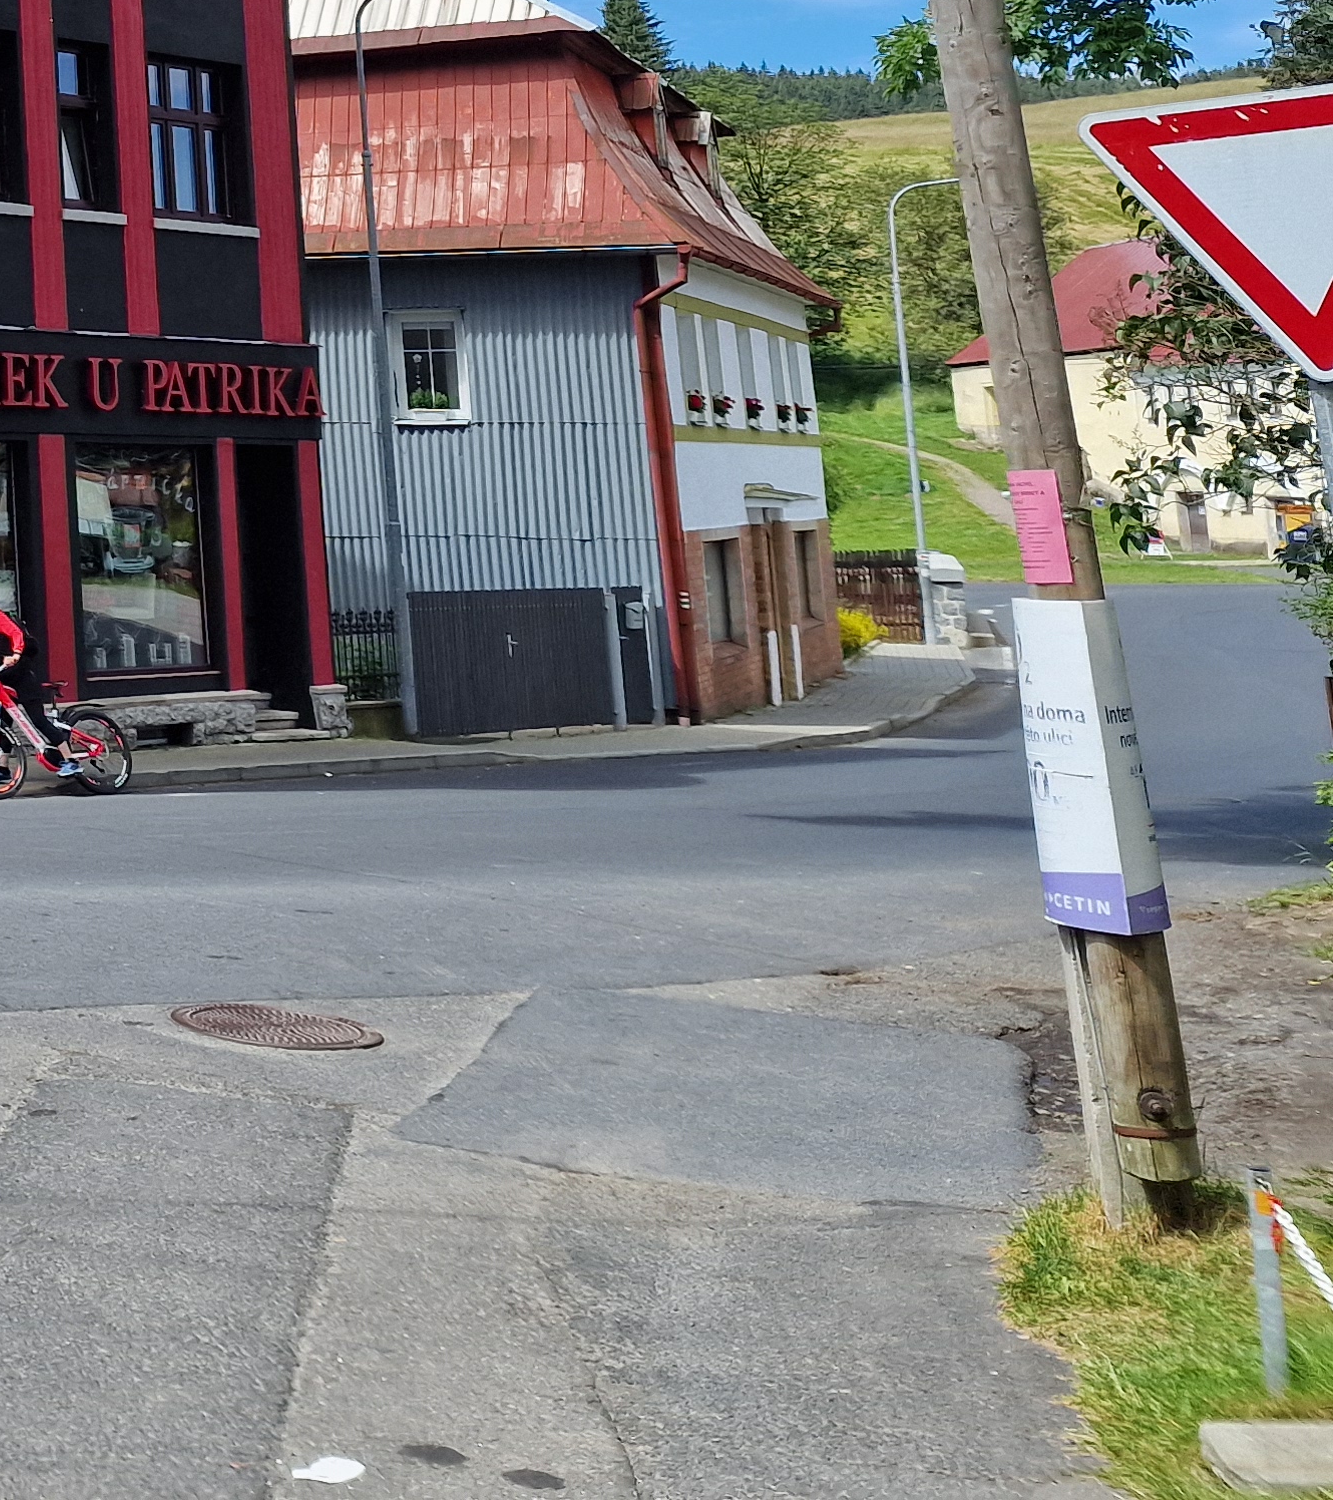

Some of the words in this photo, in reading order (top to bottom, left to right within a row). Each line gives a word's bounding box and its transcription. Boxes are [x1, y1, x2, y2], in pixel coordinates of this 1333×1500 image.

[87, 357, 122, 412] U
[141, 359, 326, 418] PATRIKA
[1036, 701, 1086, 724] doma
[1053, 892, 1112, 916] CETIN
